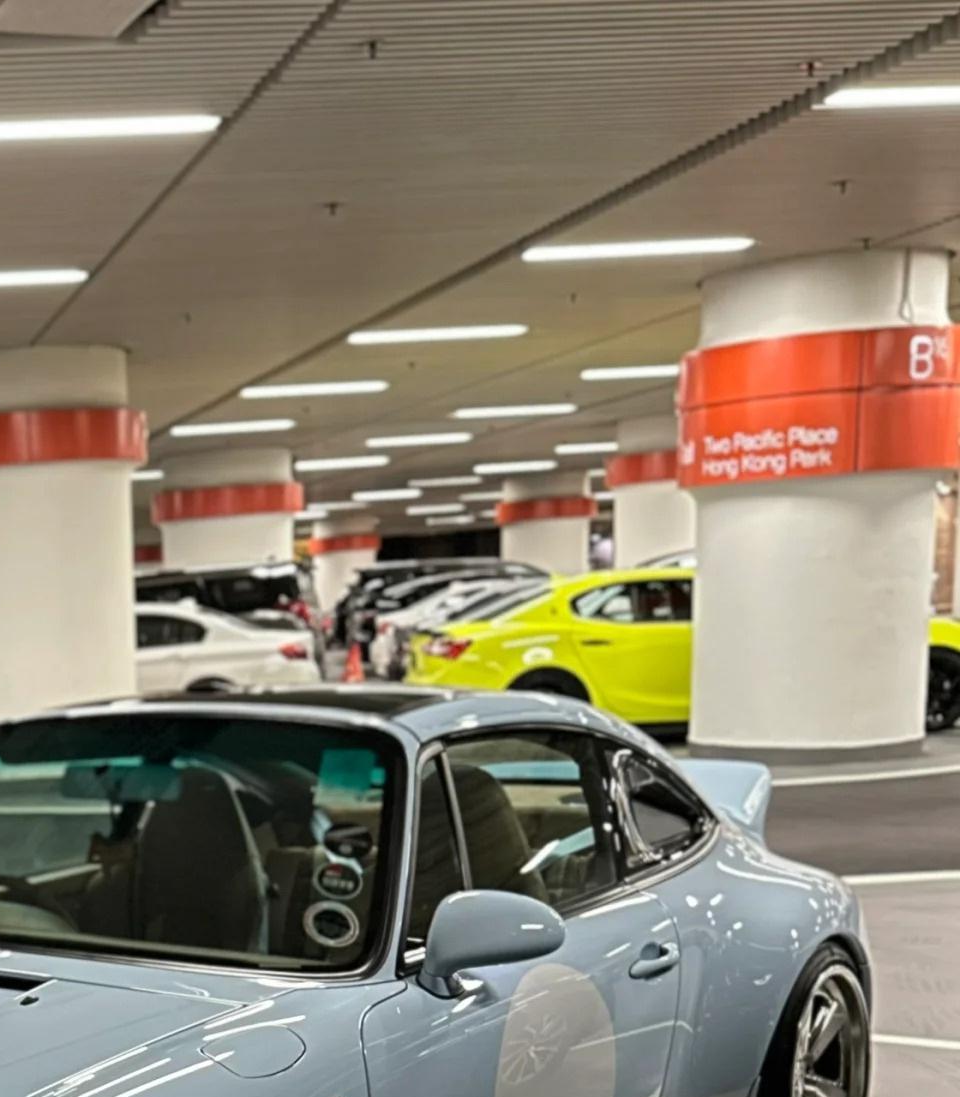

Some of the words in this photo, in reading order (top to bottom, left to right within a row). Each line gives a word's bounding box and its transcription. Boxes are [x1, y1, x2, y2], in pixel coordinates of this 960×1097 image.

[704, 435, 731, 455] Two
[733, 428, 785, 451] Pacific
[787, 425, 839, 447] Place
[702, 458, 739, 480] Hong
[741, 453, 787, 475] Kong
[790, 448, 833, 469] Park
